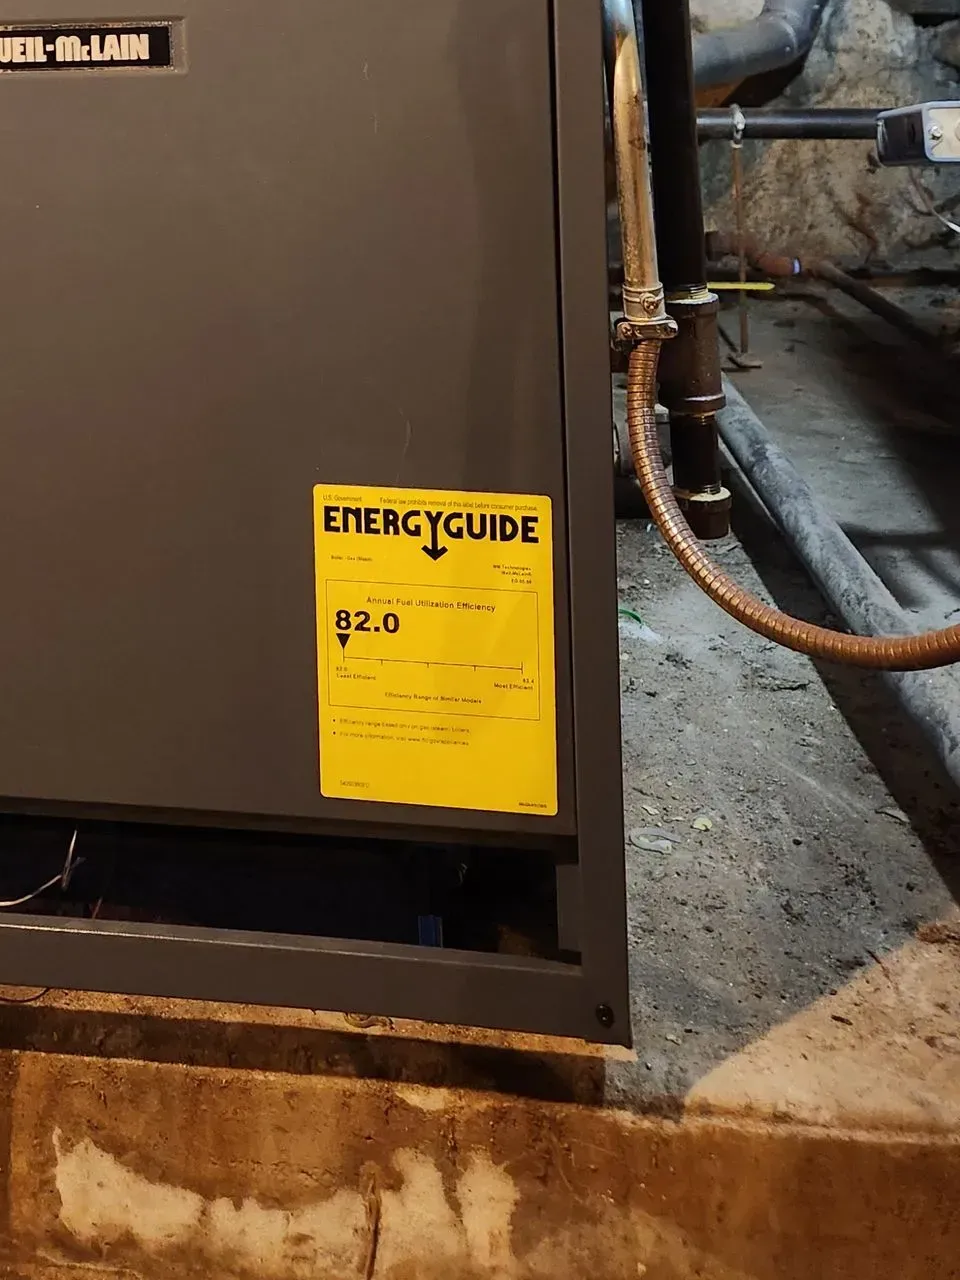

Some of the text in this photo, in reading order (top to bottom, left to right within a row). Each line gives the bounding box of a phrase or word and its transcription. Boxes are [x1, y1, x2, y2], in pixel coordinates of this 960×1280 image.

[366, 596, 496, 613] Annual Fuel Utilization Efficiency
[335, 609, 400, 634] 82.0
